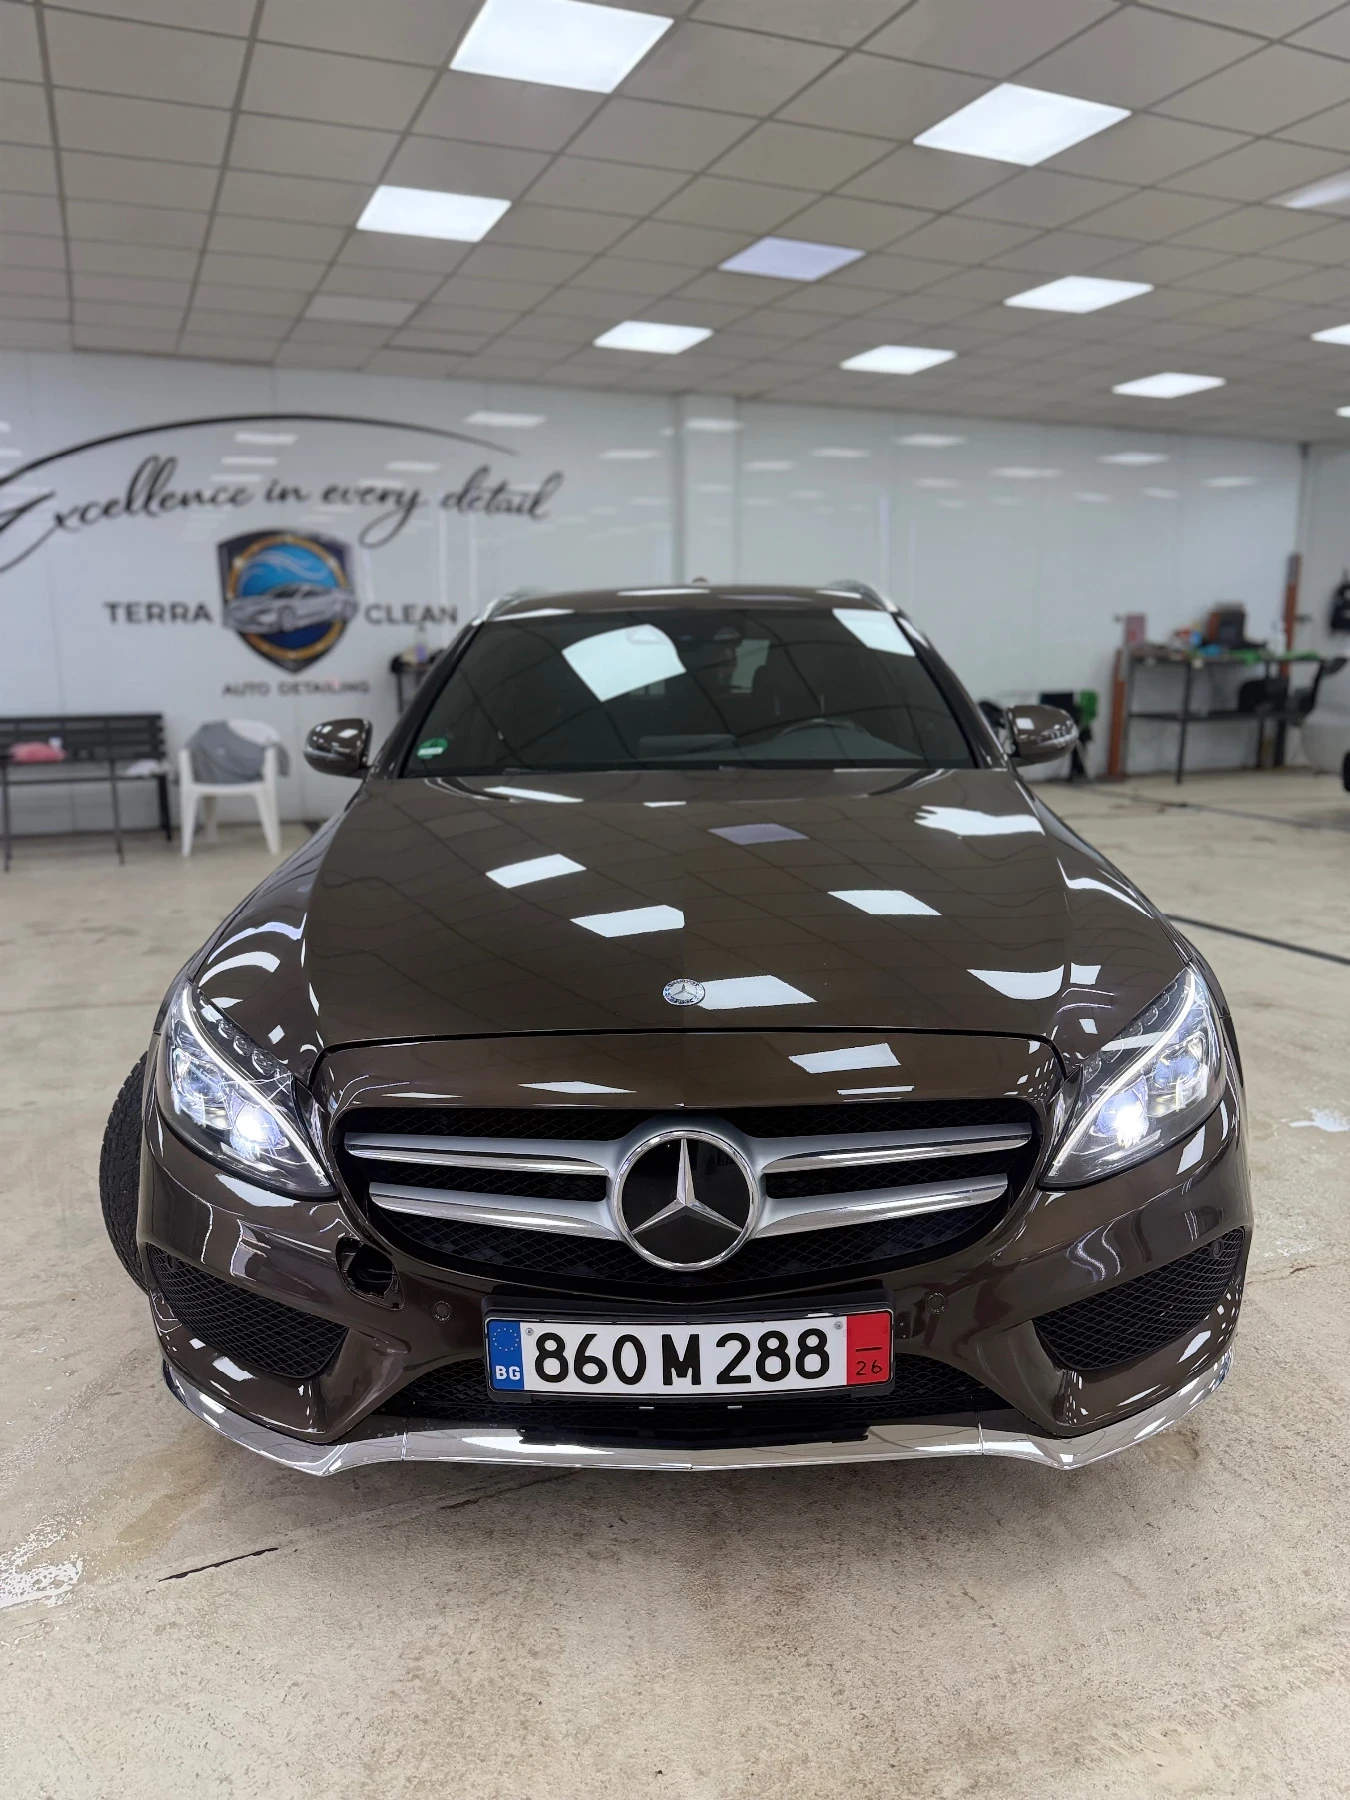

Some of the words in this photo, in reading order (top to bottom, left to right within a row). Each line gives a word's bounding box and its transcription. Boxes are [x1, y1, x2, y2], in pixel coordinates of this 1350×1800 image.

[265, 478, 309, 503] in
[321, 481, 421, 549] every
[439, 464, 565, 521] detail
[104, 602, 213, 625] TERRA
[365, 603, 459, 626] CLEAN
[222, 680, 271, 697] AUTO
[534, 1332, 647, 1386] 860
[661, 1333, 702, 1386] M
[716, 1327, 830, 1384] 288
[495, 1364, 521, 1381] BG
[855, 1359, 883, 1376] 26
